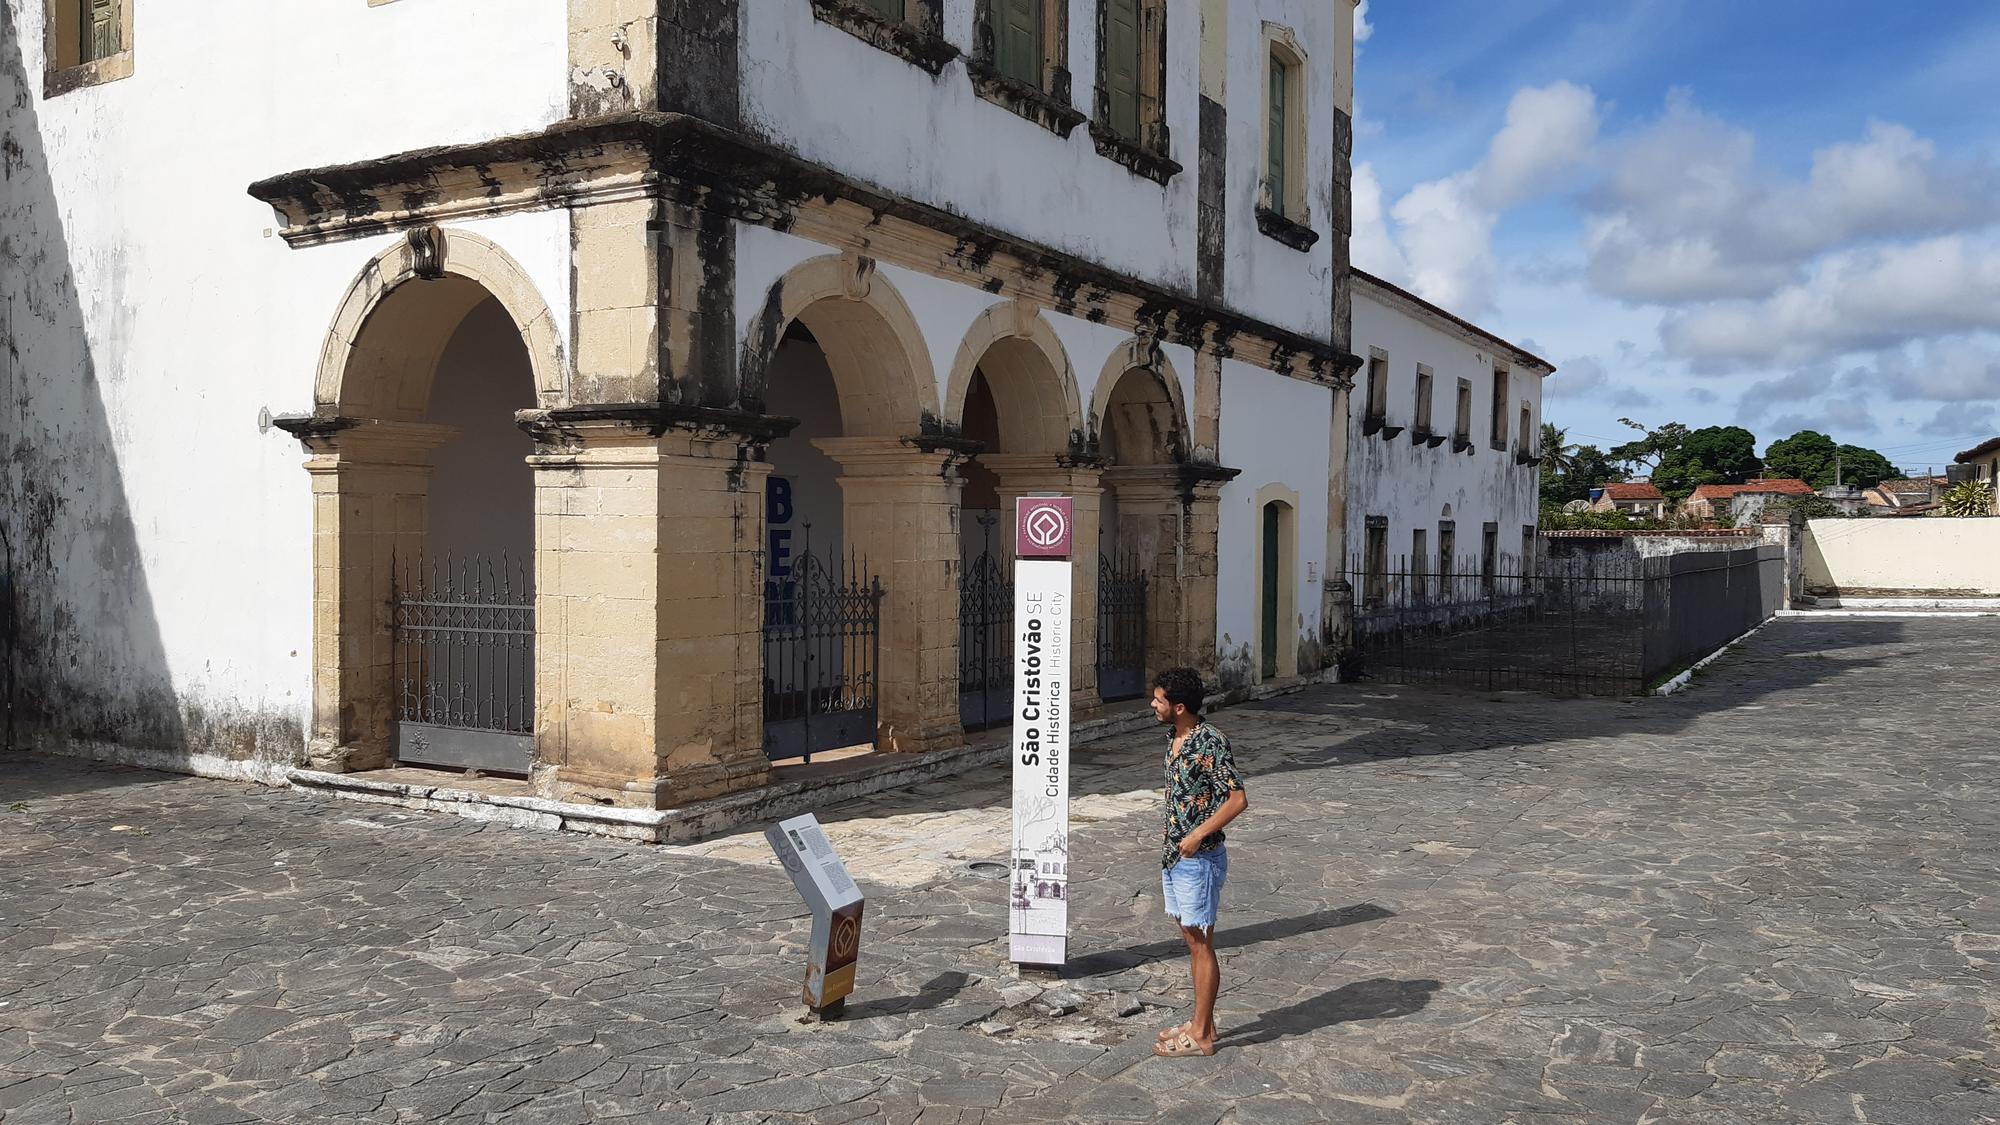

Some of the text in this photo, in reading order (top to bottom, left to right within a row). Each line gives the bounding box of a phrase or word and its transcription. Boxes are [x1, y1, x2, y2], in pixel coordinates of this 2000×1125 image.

[1021, 592, 1042, 766] São Cristóvão SE
[1046, 592, 1064, 797] Cidade Histórica Historic City
